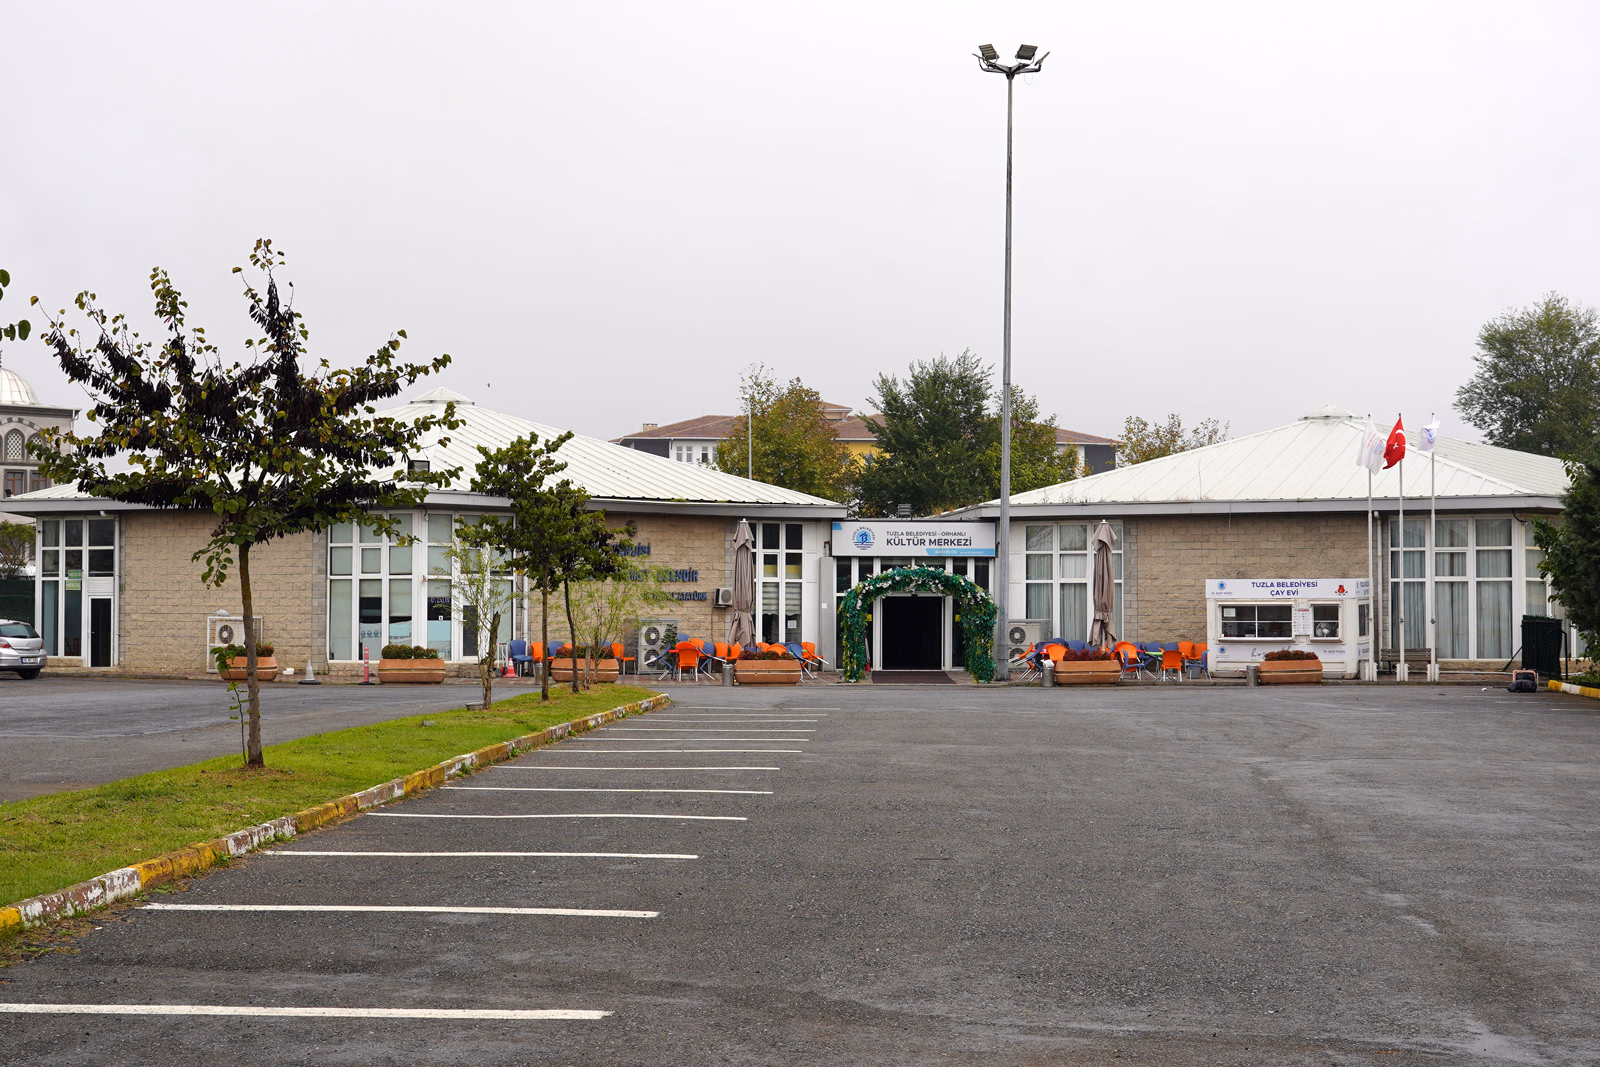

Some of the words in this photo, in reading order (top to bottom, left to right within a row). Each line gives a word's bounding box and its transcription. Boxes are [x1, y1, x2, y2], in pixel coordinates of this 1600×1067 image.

[886, 536, 926, 546] KÜLTÜR
[928, 536, 972, 546] MERKEZİ
[1276, 580, 1318, 588] BELEDİYESİ
[677, 590, 708, 601] ATATÜRK
[1270, 589, 1285, 597] ÇAY
[1286, 588, 1299, 596] EVİ
